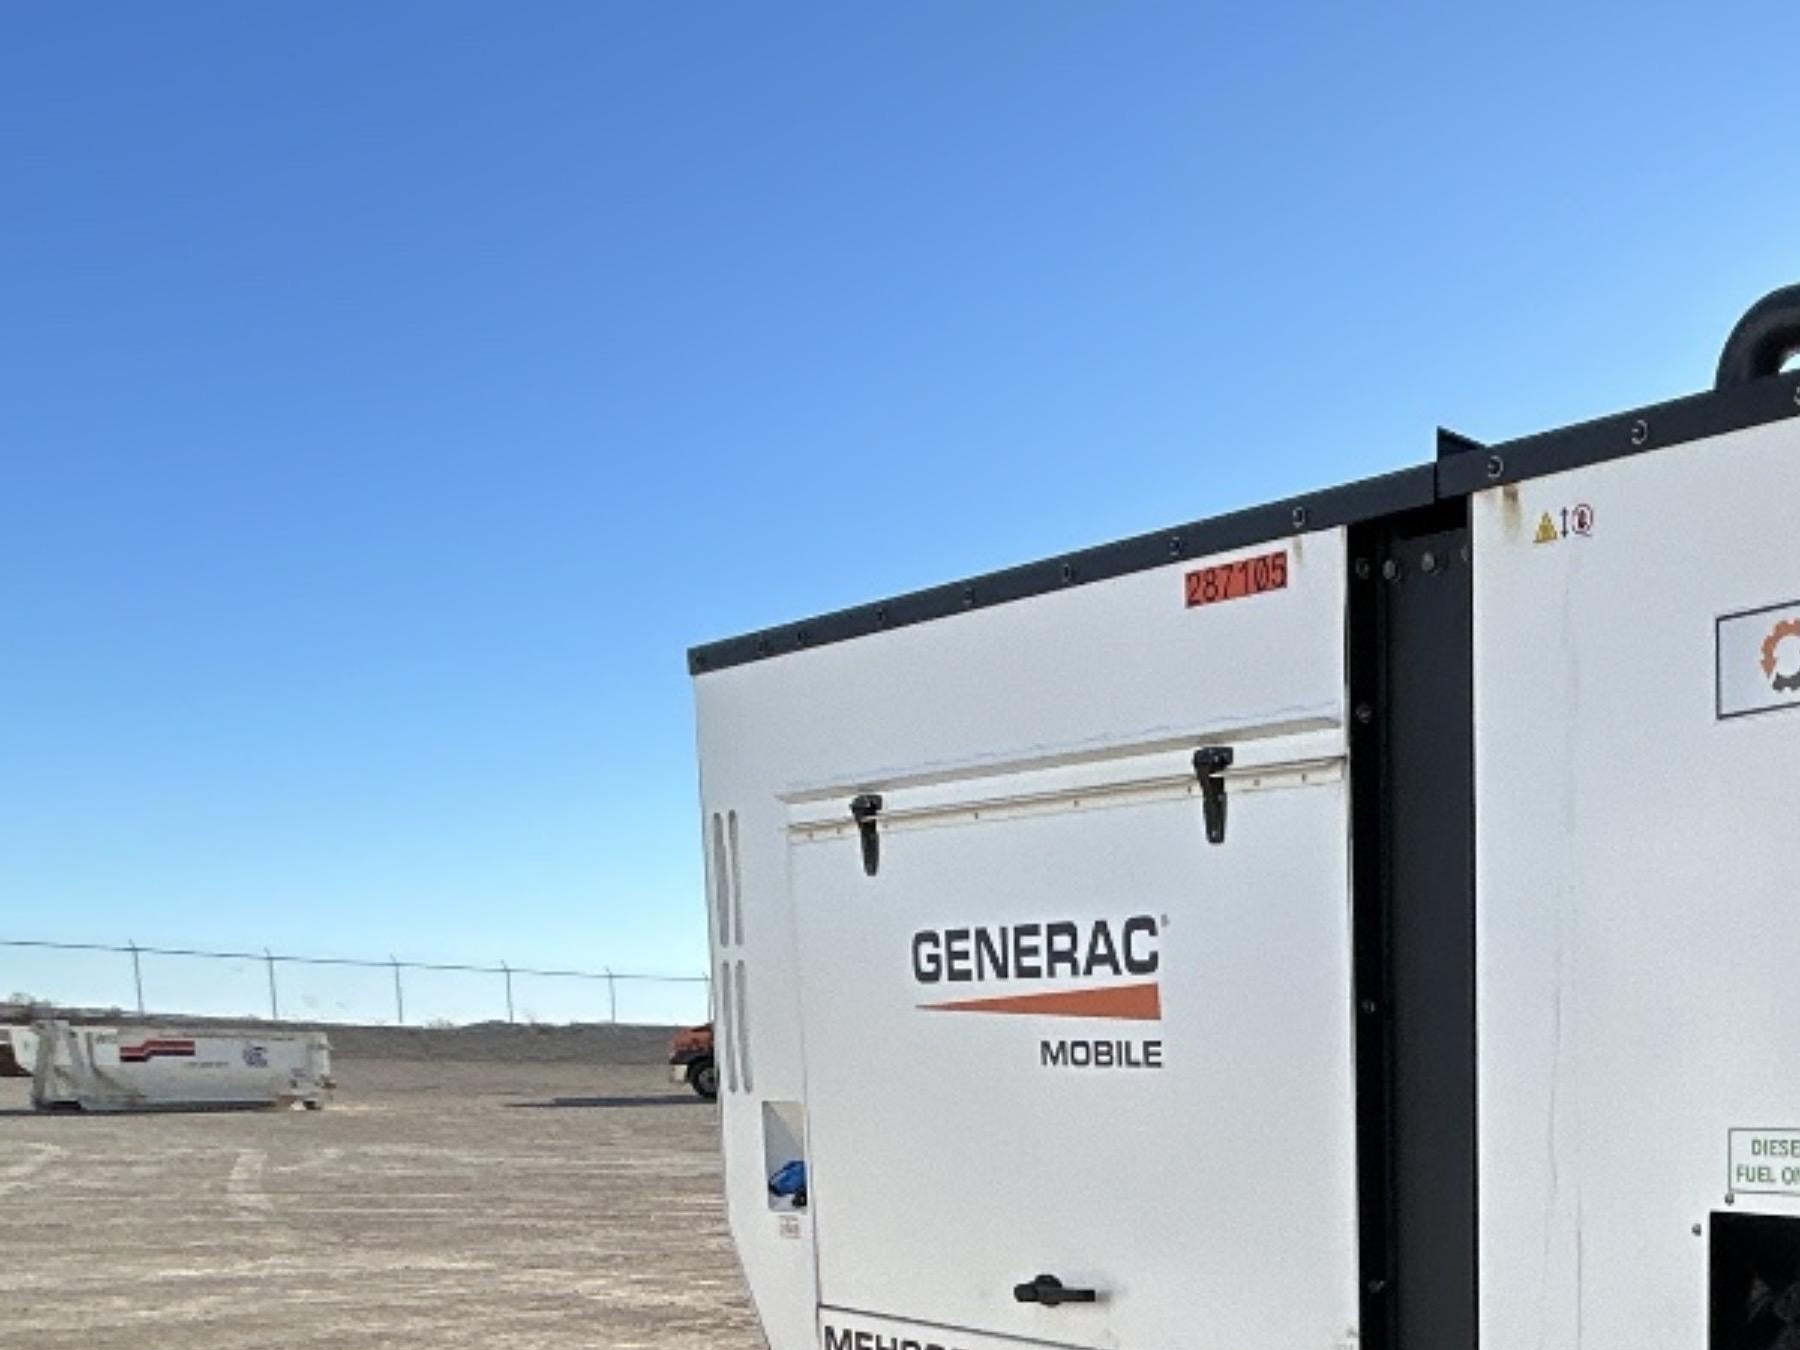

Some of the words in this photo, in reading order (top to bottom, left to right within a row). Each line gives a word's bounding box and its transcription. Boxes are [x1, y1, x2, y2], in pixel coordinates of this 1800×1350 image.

[1187, 553, 1287, 606] 287105
[911, 914, 1159, 984] GENERAC
[1040, 1040, 1163, 1068] MOBILE
[1736, 1165, 1776, 1184] FUEL
